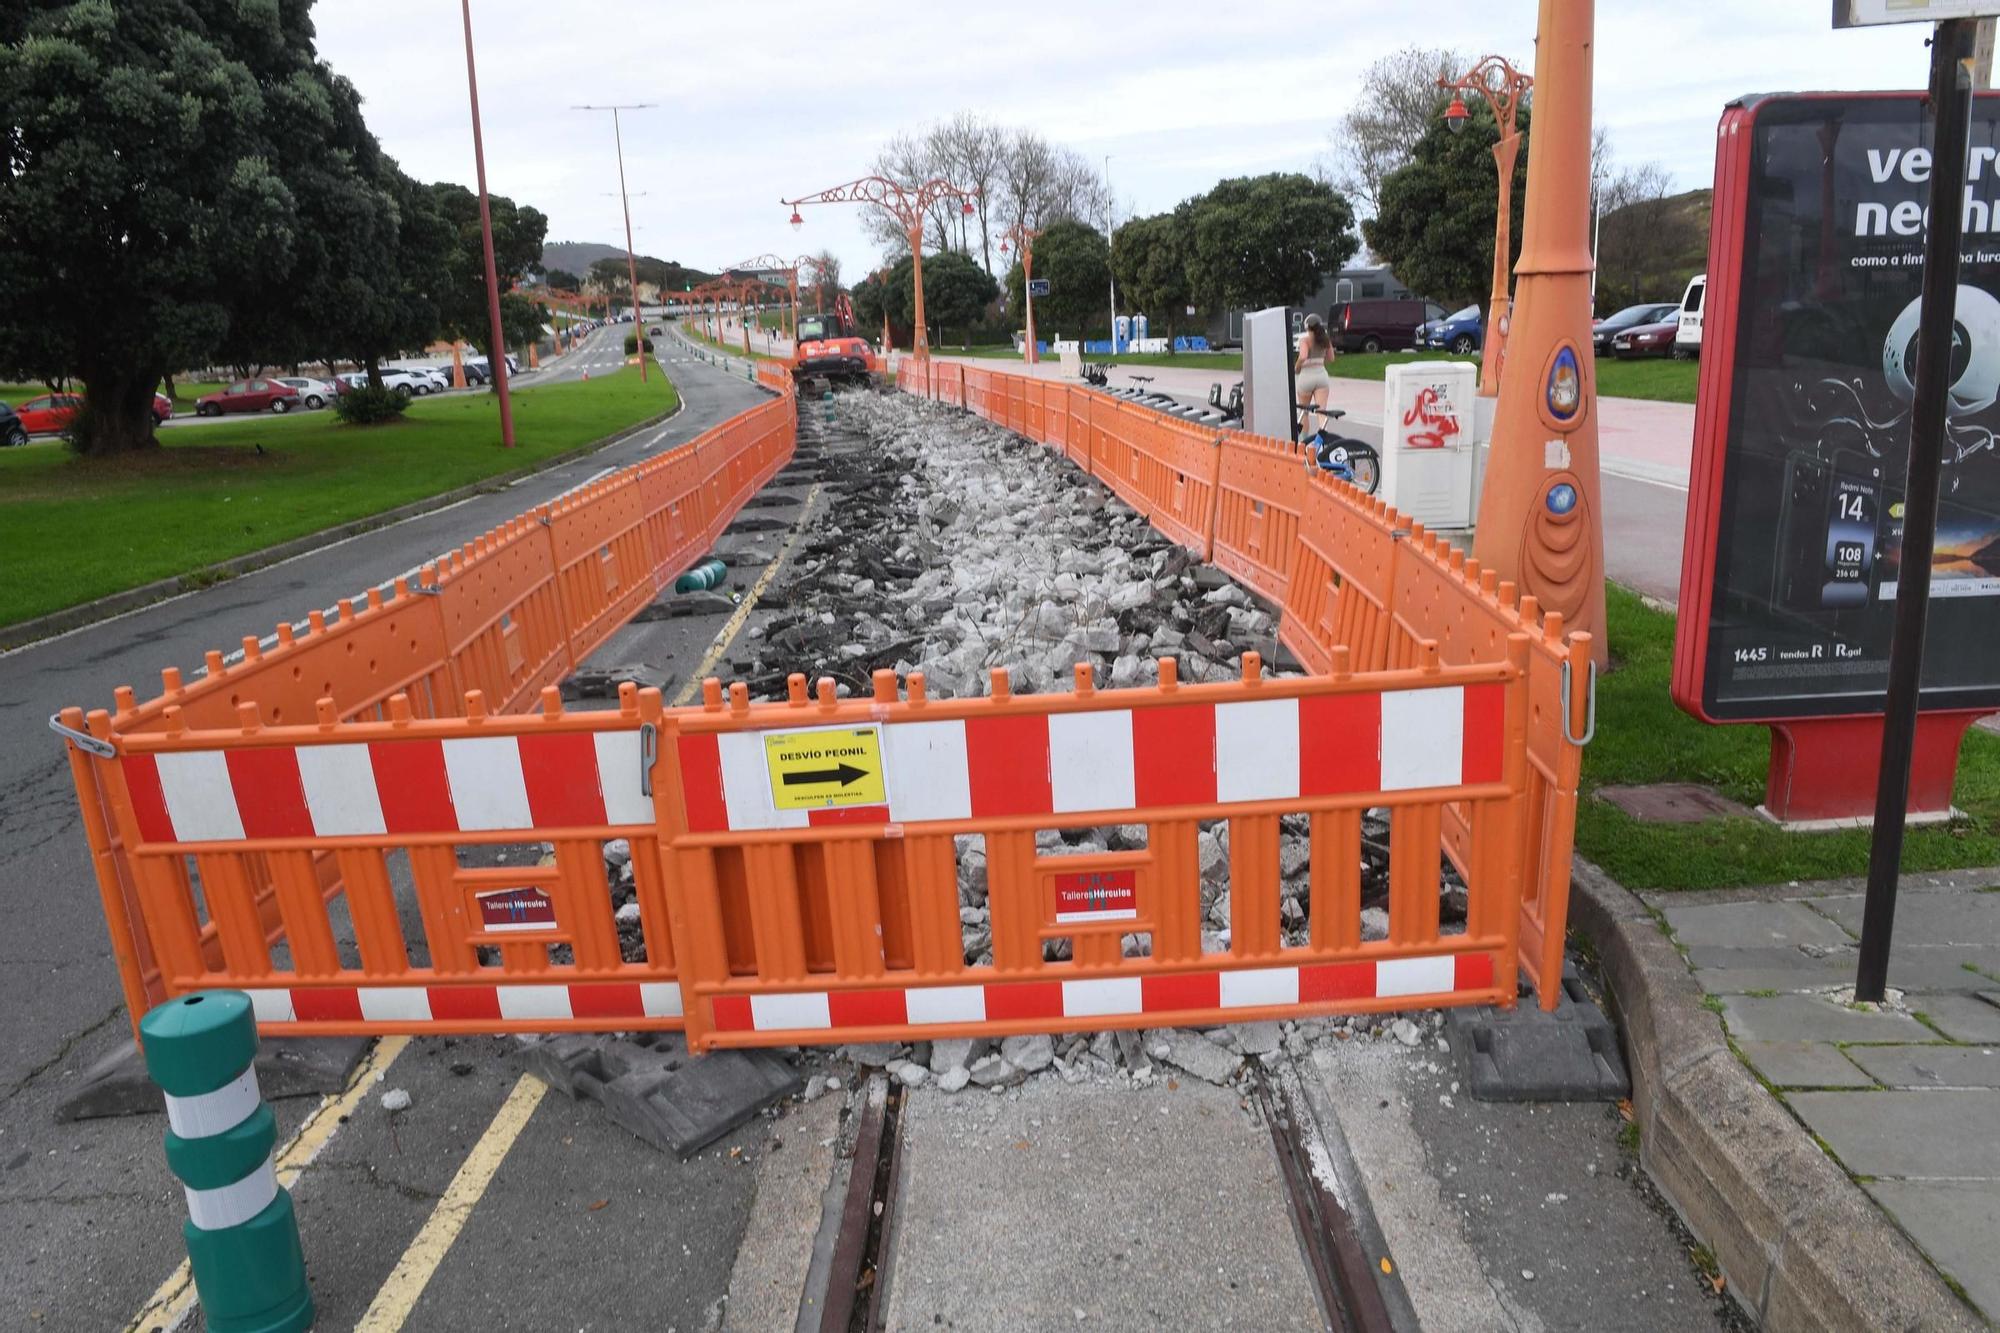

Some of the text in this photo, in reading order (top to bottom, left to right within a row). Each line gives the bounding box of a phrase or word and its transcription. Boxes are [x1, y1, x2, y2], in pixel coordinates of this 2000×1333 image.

[1867, 147, 2000, 183] ver
[1855, 185, 2000, 244] neh
[1851, 256, 1888, 267] como
[1890, 256, 1899, 265] a
[1902, 251, 1925, 265] tint
[1838, 493, 1863, 521] 14
[1839, 547, 1861, 561] 108
[1734, 647, 1767, 663] 1445
[1780, 644, 1823, 660] tendas R
[1835, 643, 1862, 658] R.gal
[825, 747, 866, 757] PEONIL
